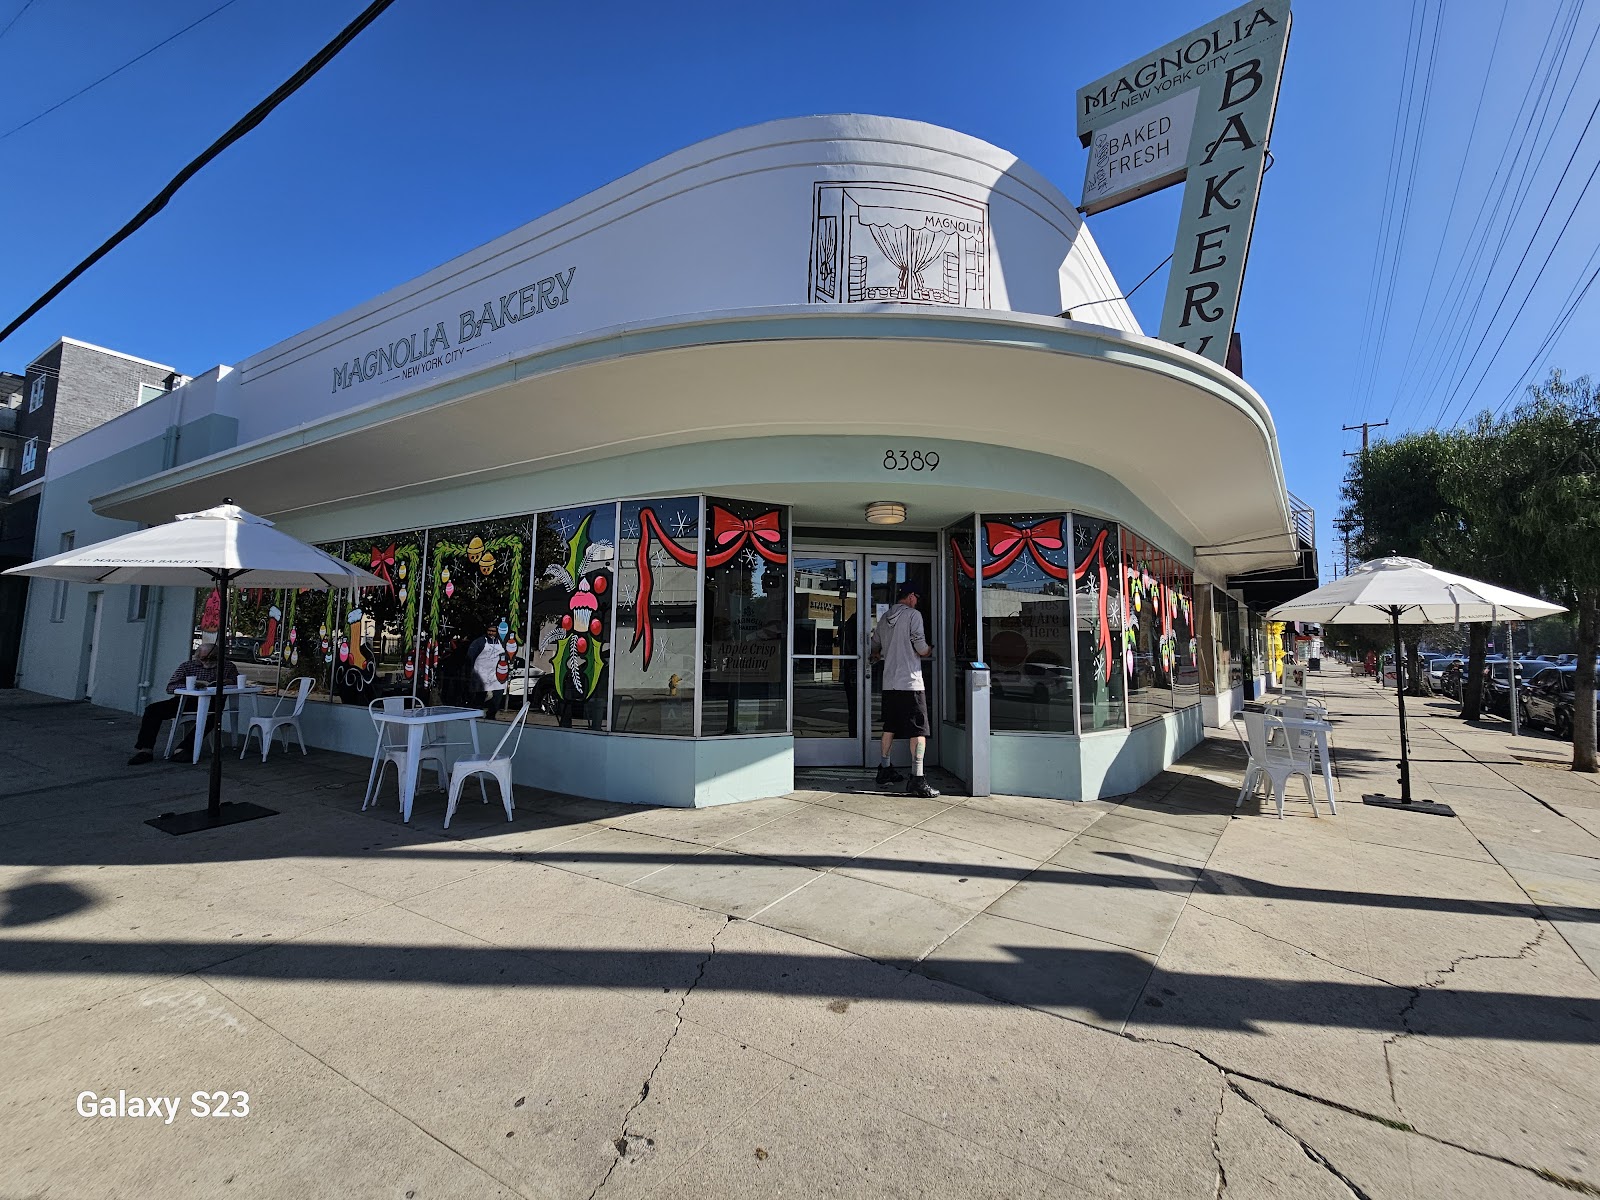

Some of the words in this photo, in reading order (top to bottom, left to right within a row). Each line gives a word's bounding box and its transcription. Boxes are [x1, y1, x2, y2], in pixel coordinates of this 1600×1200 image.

[1084, 6, 1278, 116] MAGNOLIA
[1121, 89, 1152, 110] NEW
[1154, 73, 1191, 94] YORK
[1196, 52, 1230, 76] CITY
[1109, 116, 1172, 157] BAKED
[1108, 139, 1170, 179] FRESH
[924, 215, 983, 235] MAGNOLIA
[331, 321, 450, 394] MAGNOLIA
[457, 266, 577, 345] BAKERY
[401, 365, 421, 380] NEW
[422, 355, 443, 373] YORK
[445, 347, 466, 364] CITY
[883, 449, 940, 471] 8389
[1030, 626, 1059, 638] Here
[718, 642, 748, 656] Apple
[749, 643, 776, 657] Crisp
[726, 656, 769, 671] Pudding
